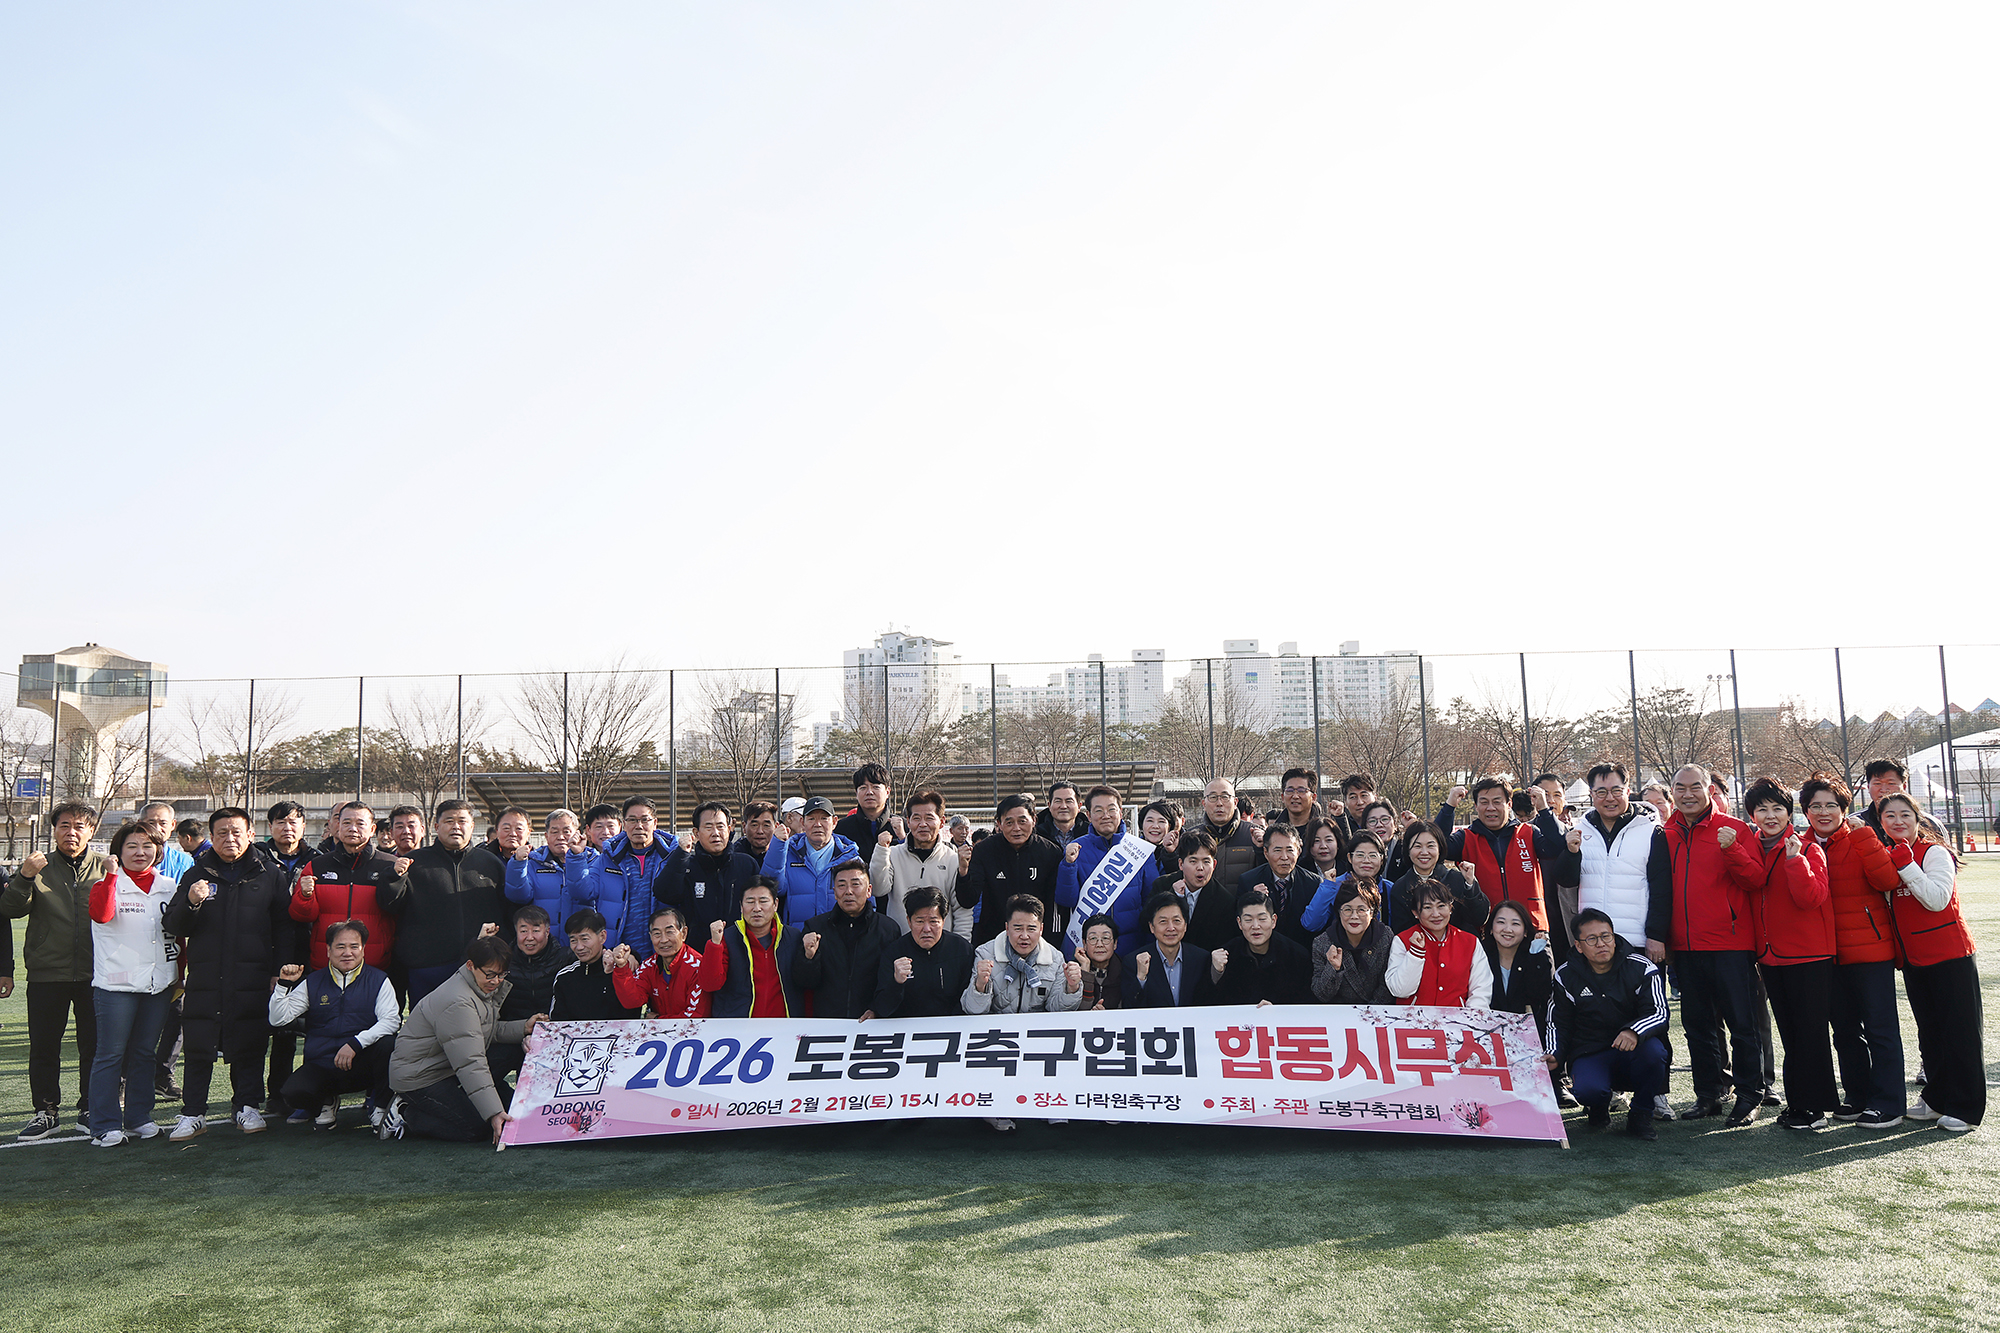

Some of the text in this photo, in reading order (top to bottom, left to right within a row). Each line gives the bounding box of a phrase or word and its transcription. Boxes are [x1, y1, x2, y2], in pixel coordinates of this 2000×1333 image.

[1076, 851, 1134, 926] 강정구
[625, 1026, 1514, 1092] 2026 도봉구축구협회 합동시무식
[541, 1099, 606, 1116] DOBONG
[547, 1116, 579, 1126] SEOUL
[687, 1092, 1442, 1121] 일시 2026년 2월 21일(토) 15시 40분 장소 다락원축구장 주최 주관 도봉구축구협회
